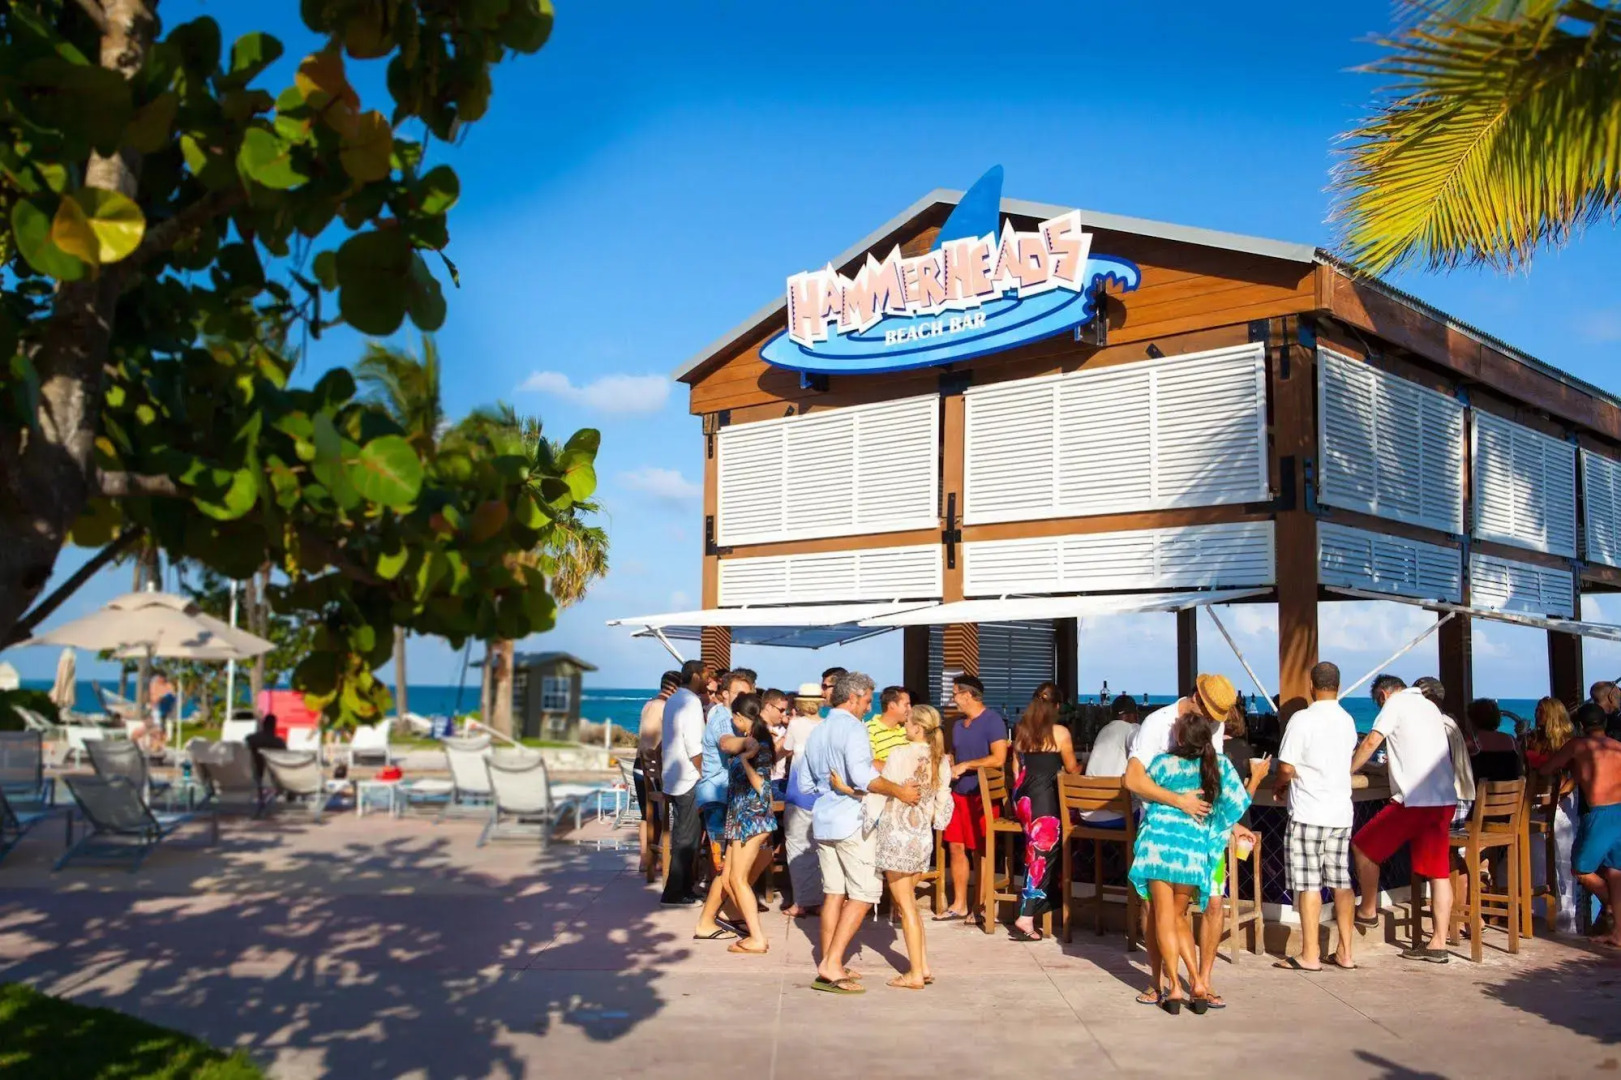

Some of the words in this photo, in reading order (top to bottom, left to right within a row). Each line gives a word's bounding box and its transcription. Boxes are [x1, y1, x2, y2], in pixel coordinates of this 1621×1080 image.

[789, 214, 1085, 343] HAMMERHEADS
[885, 320, 944, 346] BEACH
[949, 311, 987, 334] BAR
